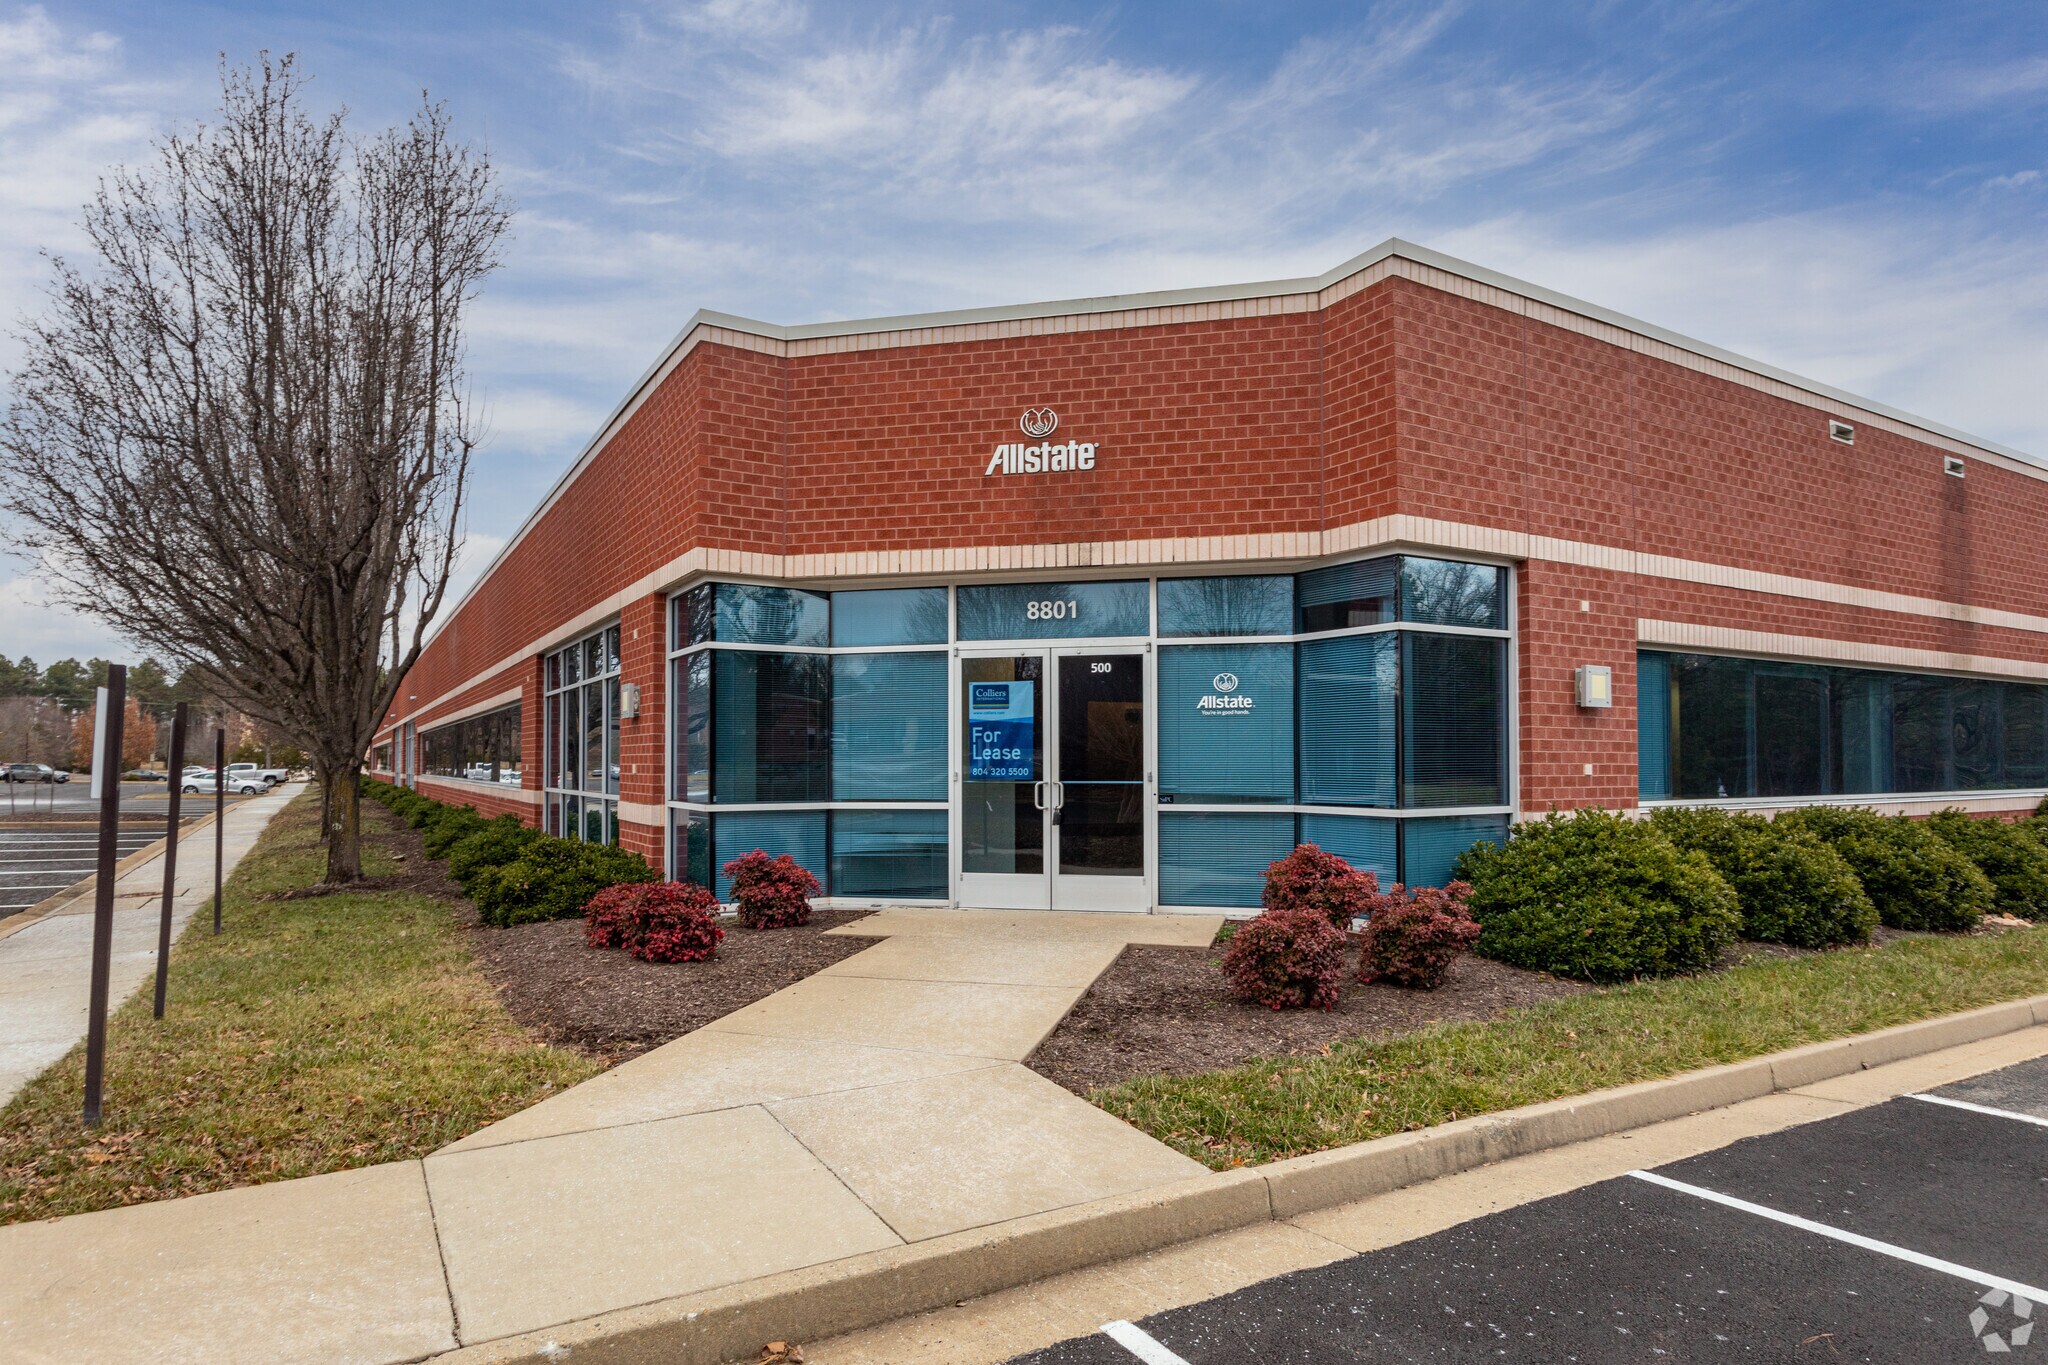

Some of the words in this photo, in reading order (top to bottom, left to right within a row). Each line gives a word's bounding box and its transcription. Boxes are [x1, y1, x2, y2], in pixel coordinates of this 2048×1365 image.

[984, 440, 1096, 475] Allstate
[1026, 600, 1077, 619] 8801
[1090, 662, 1112, 673] 500
[975, 689, 1007, 697] Colliers
[972, 727, 1002, 743] For
[972, 744, 1021, 760] Lease
[972, 767, 988, 776] 804
[990, 767, 1006, 776] 320
[1008, 767, 1029, 776] 5500
